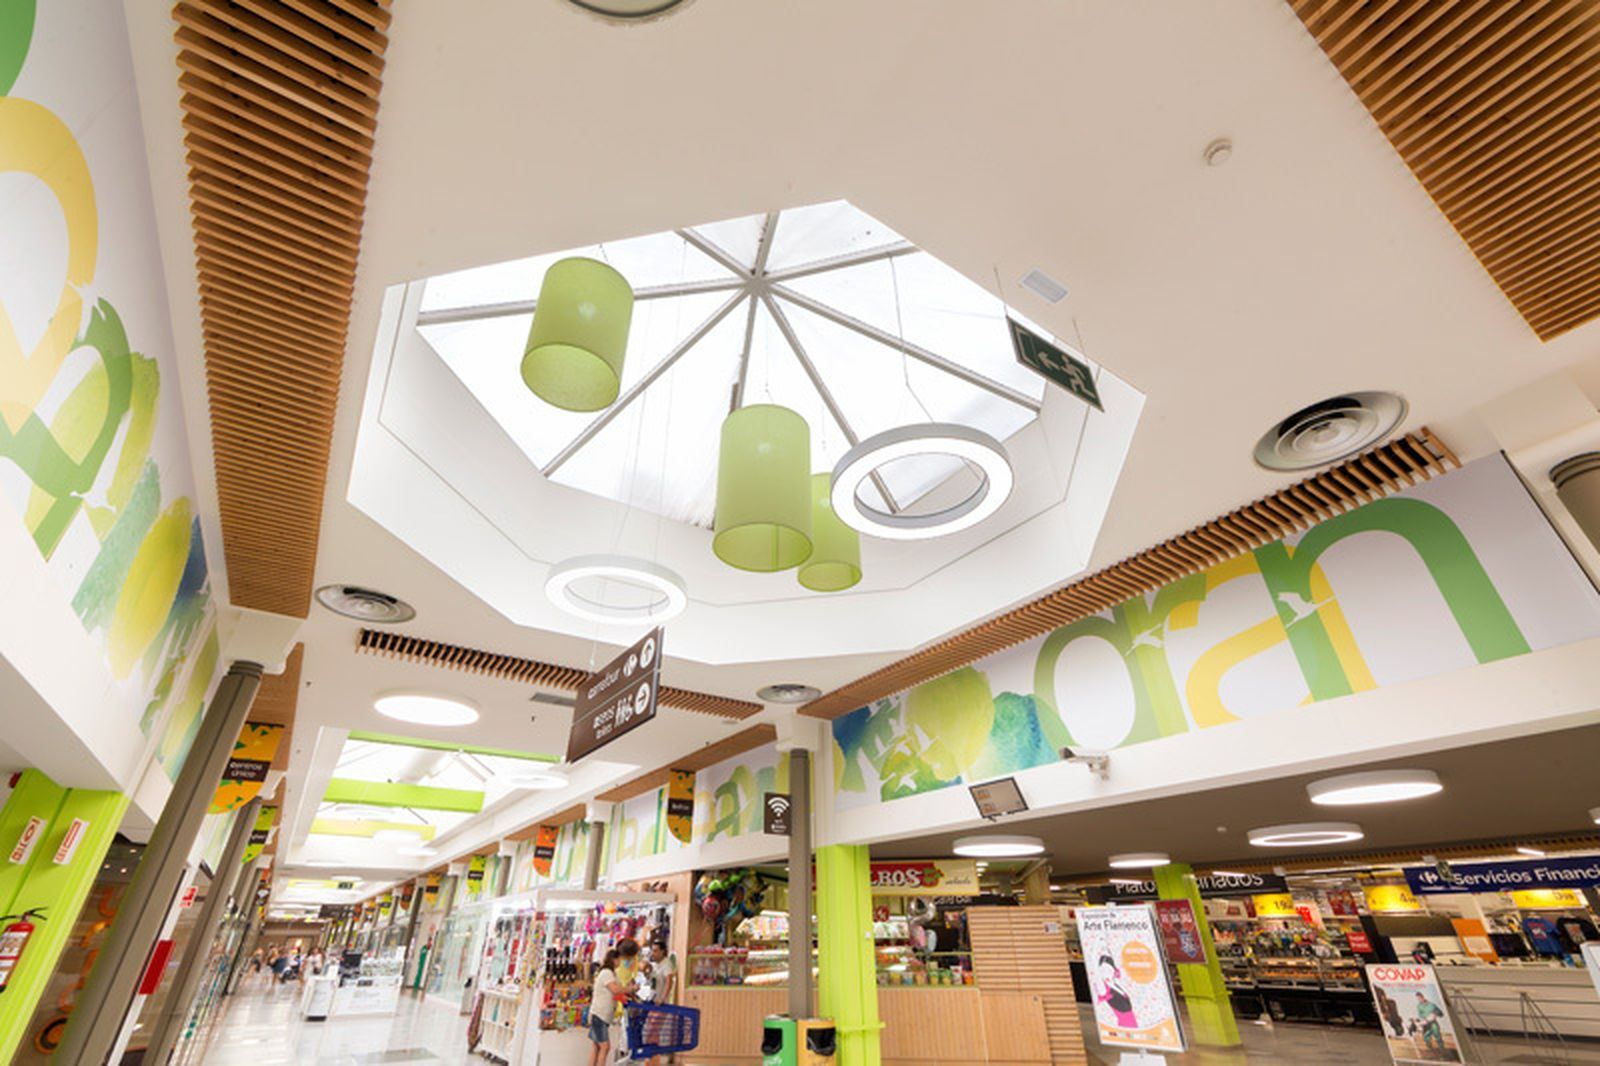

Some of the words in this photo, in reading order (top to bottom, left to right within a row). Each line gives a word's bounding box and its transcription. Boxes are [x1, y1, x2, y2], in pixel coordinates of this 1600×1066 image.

[1453, 868, 1532, 885] Servicios
[1103, 919, 1149, 931] Flamenco
[1374, 967, 1425, 981] COVAP
